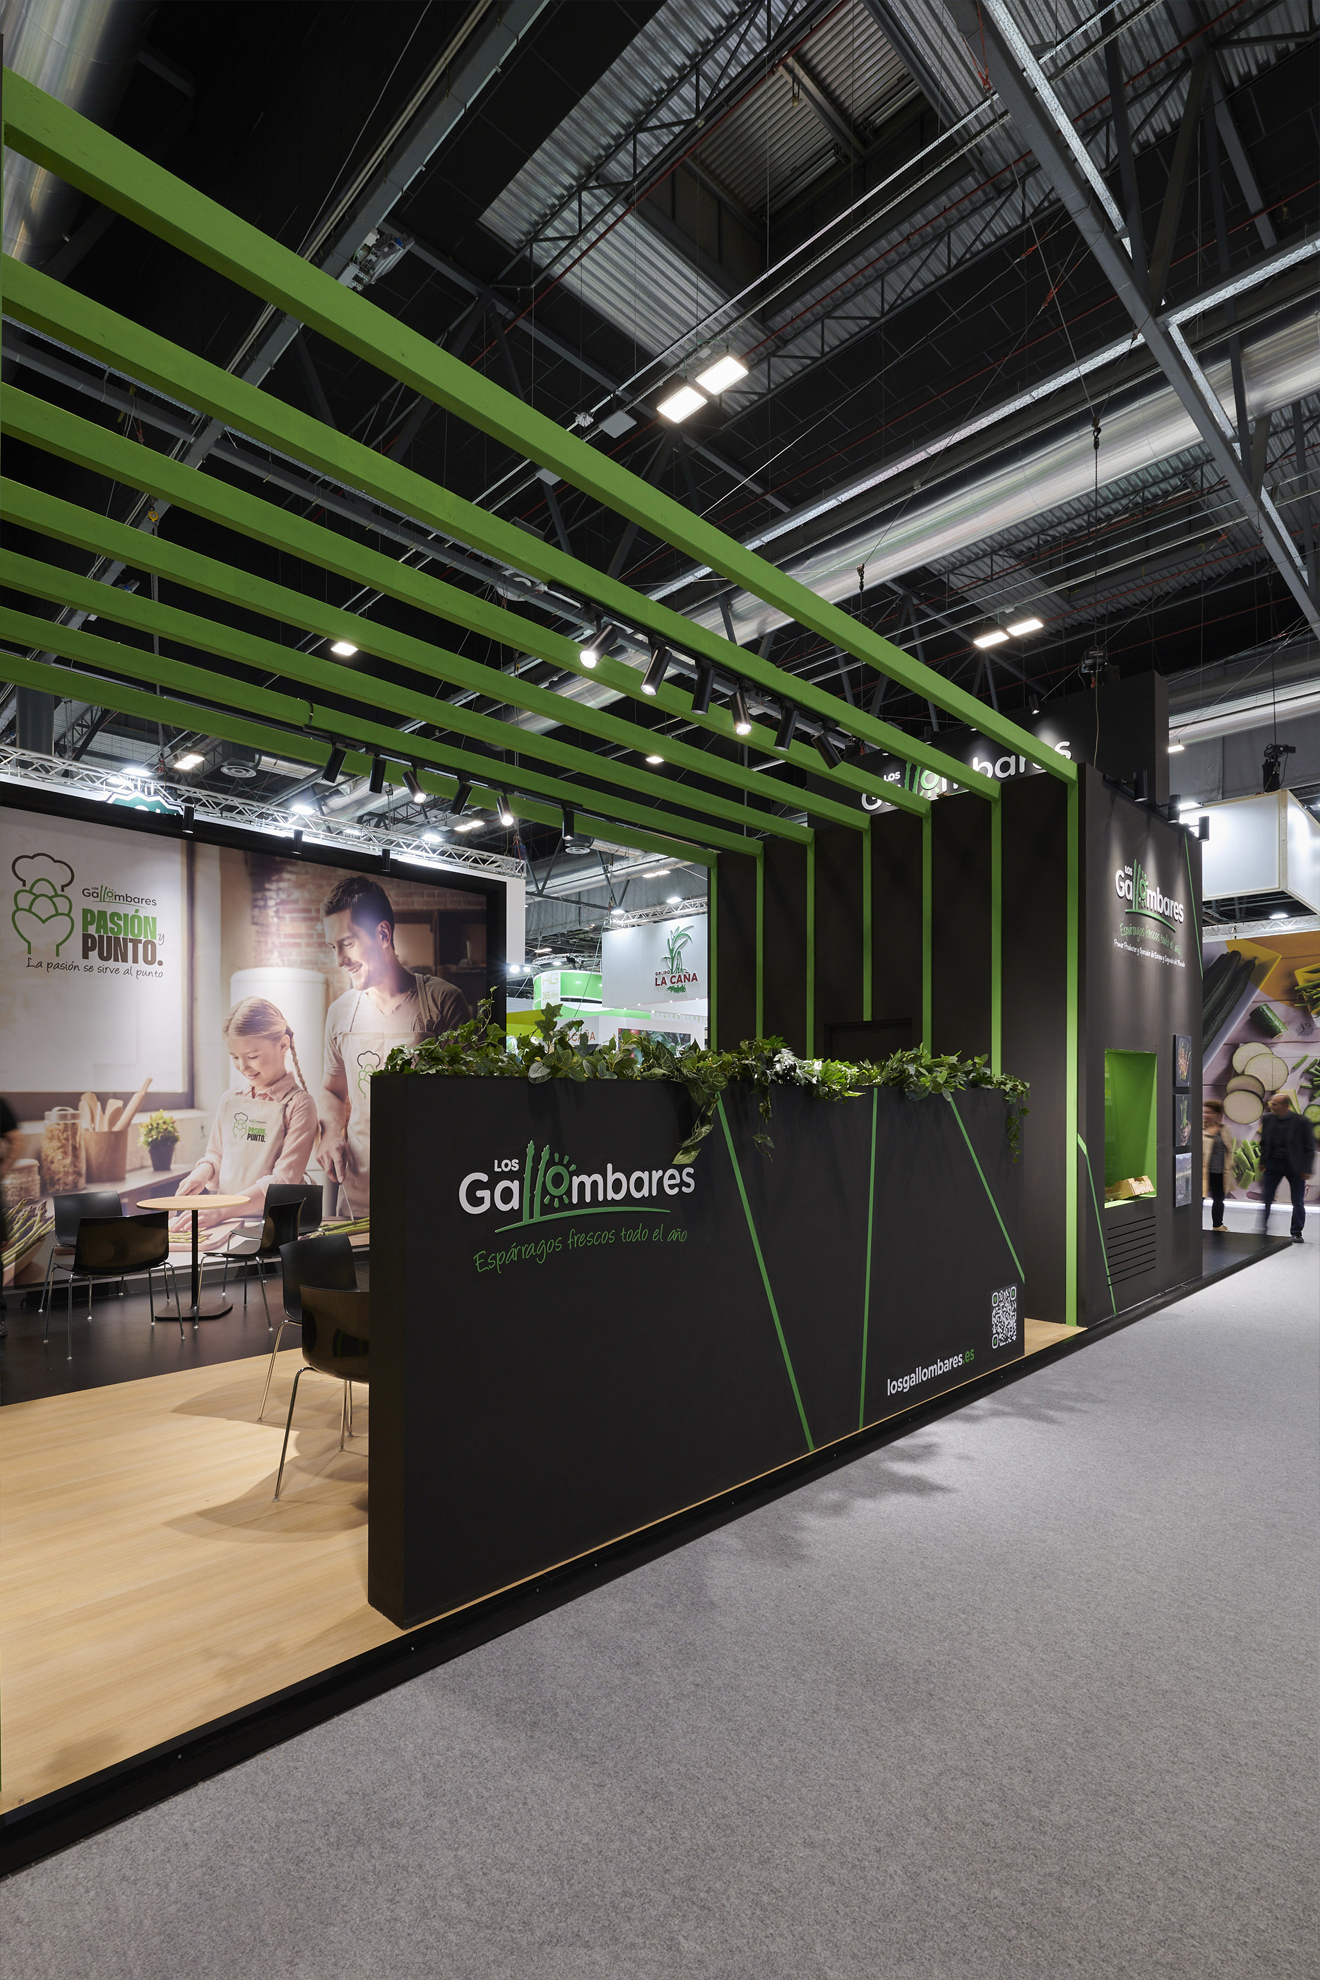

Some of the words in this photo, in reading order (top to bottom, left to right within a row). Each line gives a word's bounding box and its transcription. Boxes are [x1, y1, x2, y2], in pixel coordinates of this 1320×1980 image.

[883, 771, 901, 782] LOS
[81, 884, 157, 906] Gallombares
[1115, 858, 1184, 922] Gallombares
[81, 907, 157, 940] PASIÓN
[157, 933, 165, 946] y
[81, 932, 164, 967] PUNTO.
[26, 957, 43, 969] La
[47, 961, 81, 973] pasión
[83, 964, 95, 973] se
[97, 964, 121, 975] sirve
[122, 966, 133, 976] al
[135, 968, 164, 980] punto
[655, 976, 668, 987] LA
[669, 971, 699, 985] CAÑA
[458, 1140, 696, 1222] Gallombares
[494, 1159, 519, 1172] LOS
[473, 1236, 563, 1274] Espárragos
[567, 1228, 616, 1250] frescos
[620, 1222, 649, 1243] todo
[652, 1223, 664, 1243] el
[667, 1228, 688, 1243] año
[887, 1348, 975, 1396] losgallombares.es
